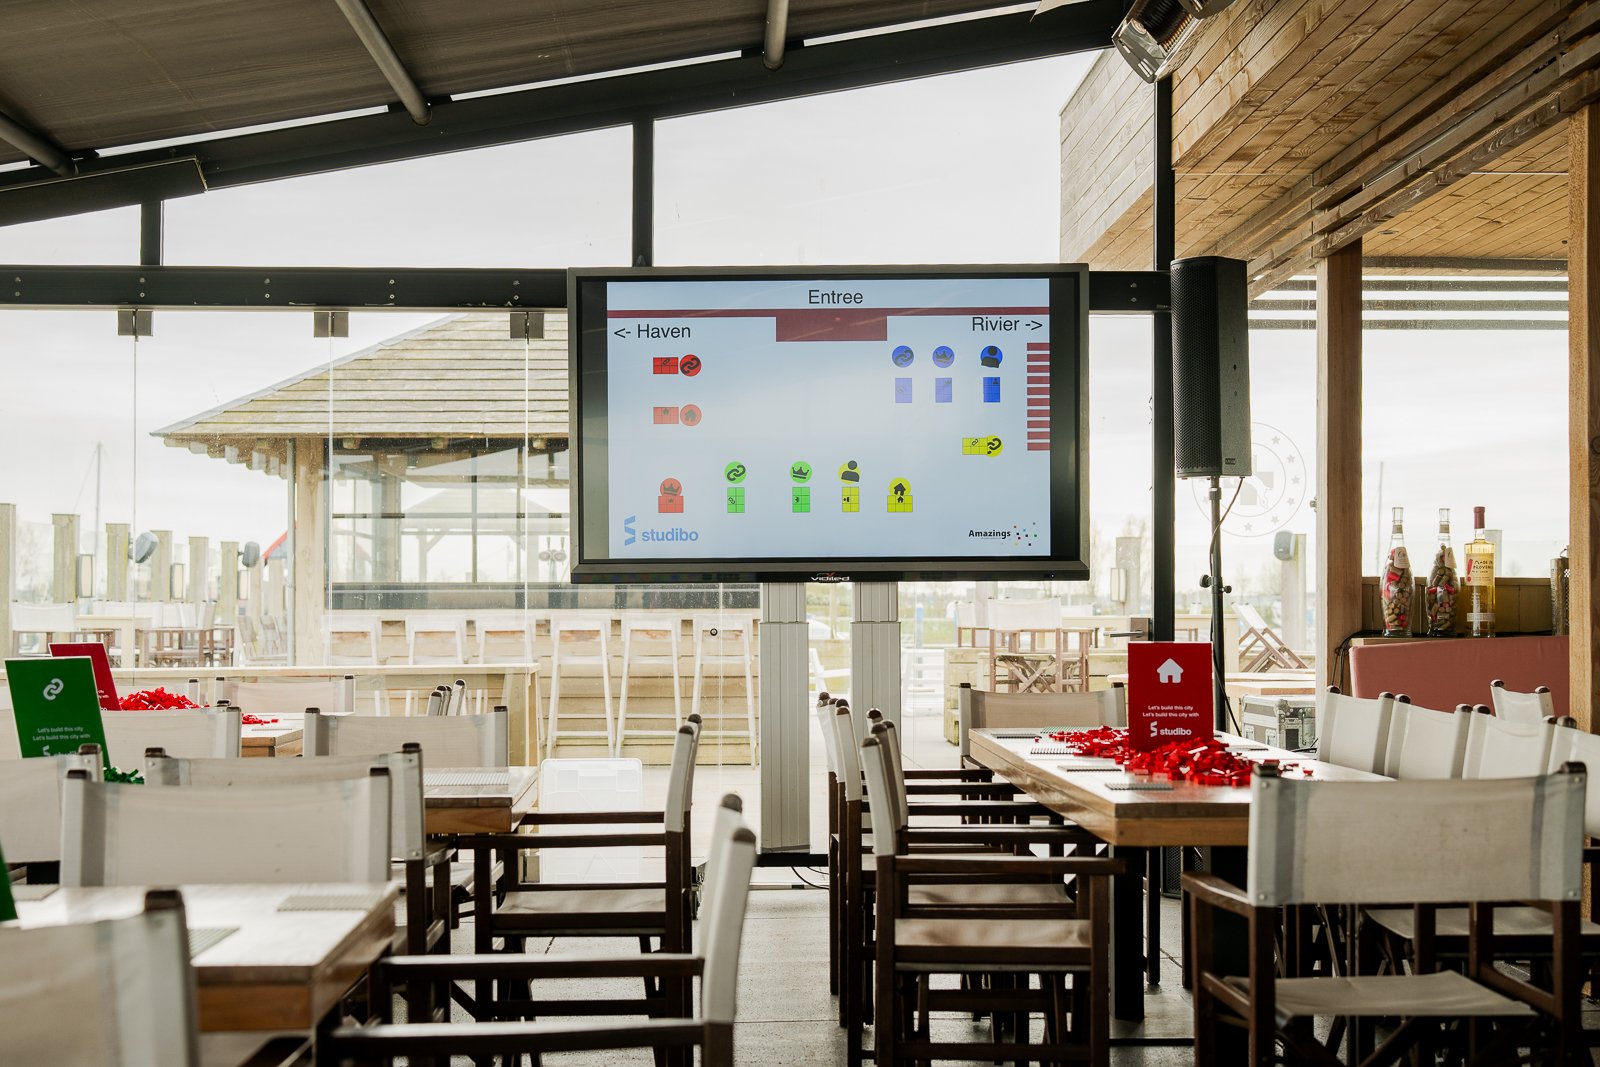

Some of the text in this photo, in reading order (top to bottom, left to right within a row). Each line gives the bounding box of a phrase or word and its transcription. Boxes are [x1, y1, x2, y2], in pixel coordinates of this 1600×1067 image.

[809, 289, 863, 304] Entree
[972, 316, 1020, 331] Rivier
[637, 323, 691, 339] Haven
[641, 528, 699, 541] studibo
[968, 529, 1011, 540] Amazings
[1160, 728, 1192, 736] studibo
